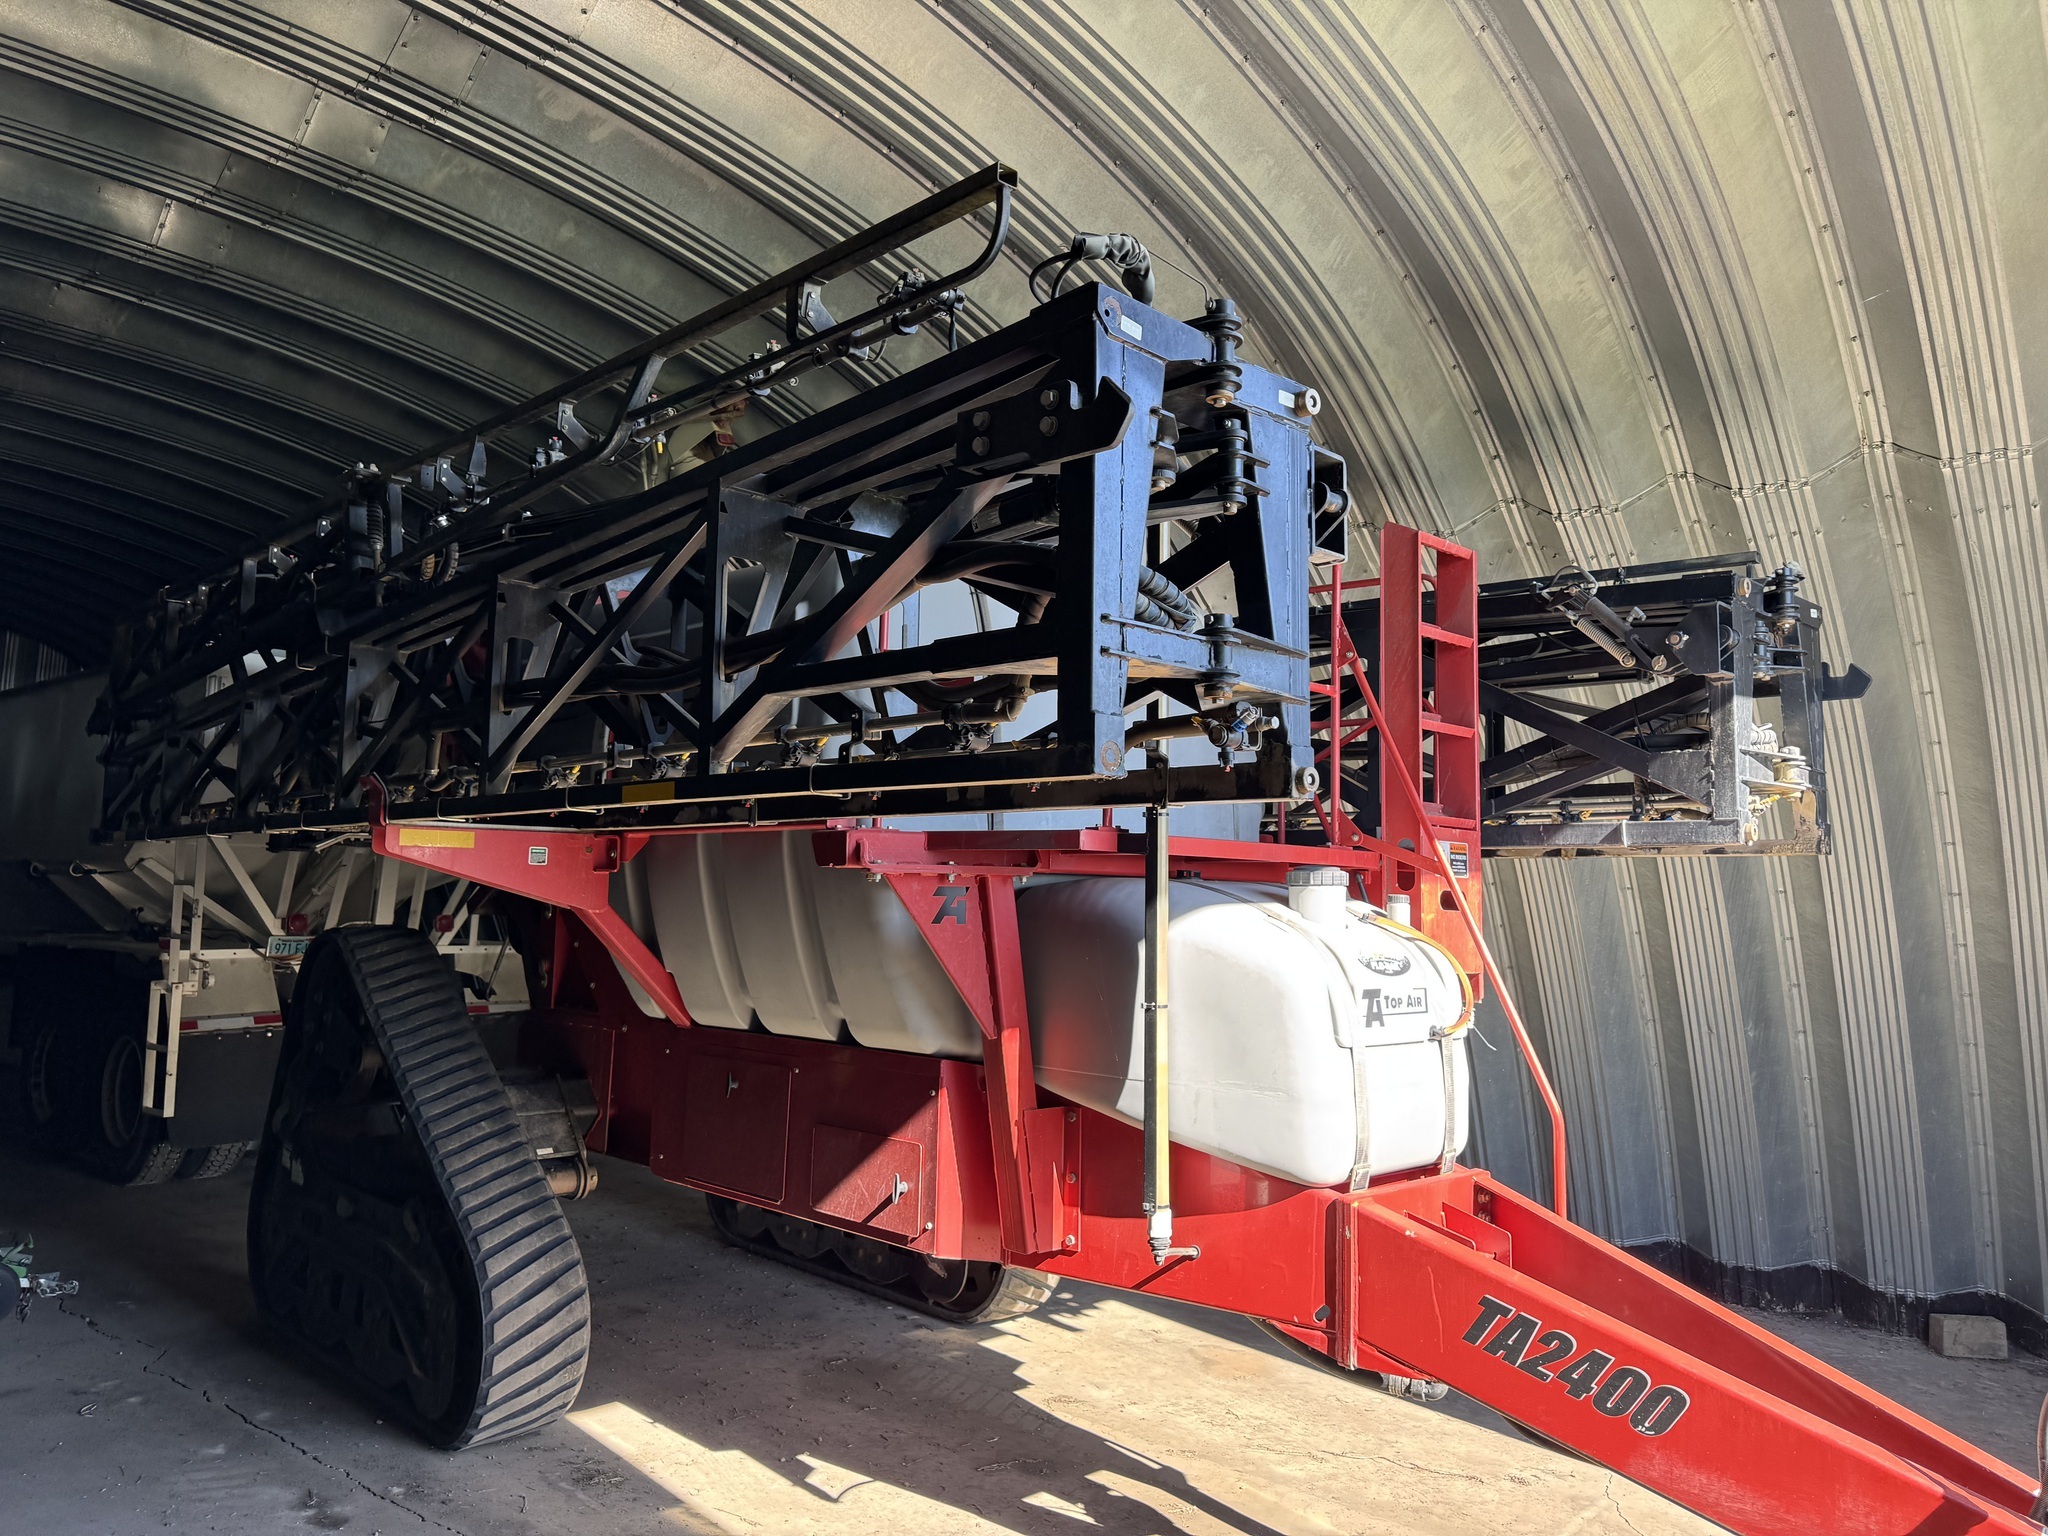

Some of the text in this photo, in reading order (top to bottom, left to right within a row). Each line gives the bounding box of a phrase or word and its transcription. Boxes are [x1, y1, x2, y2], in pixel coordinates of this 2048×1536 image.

[931, 886, 970, 925] TA
[275, 943, 291, 954] 971
[1362, 988, 1422, 1028] TA TOP AIR
[1461, 1294, 1691, 1437] TA2400
